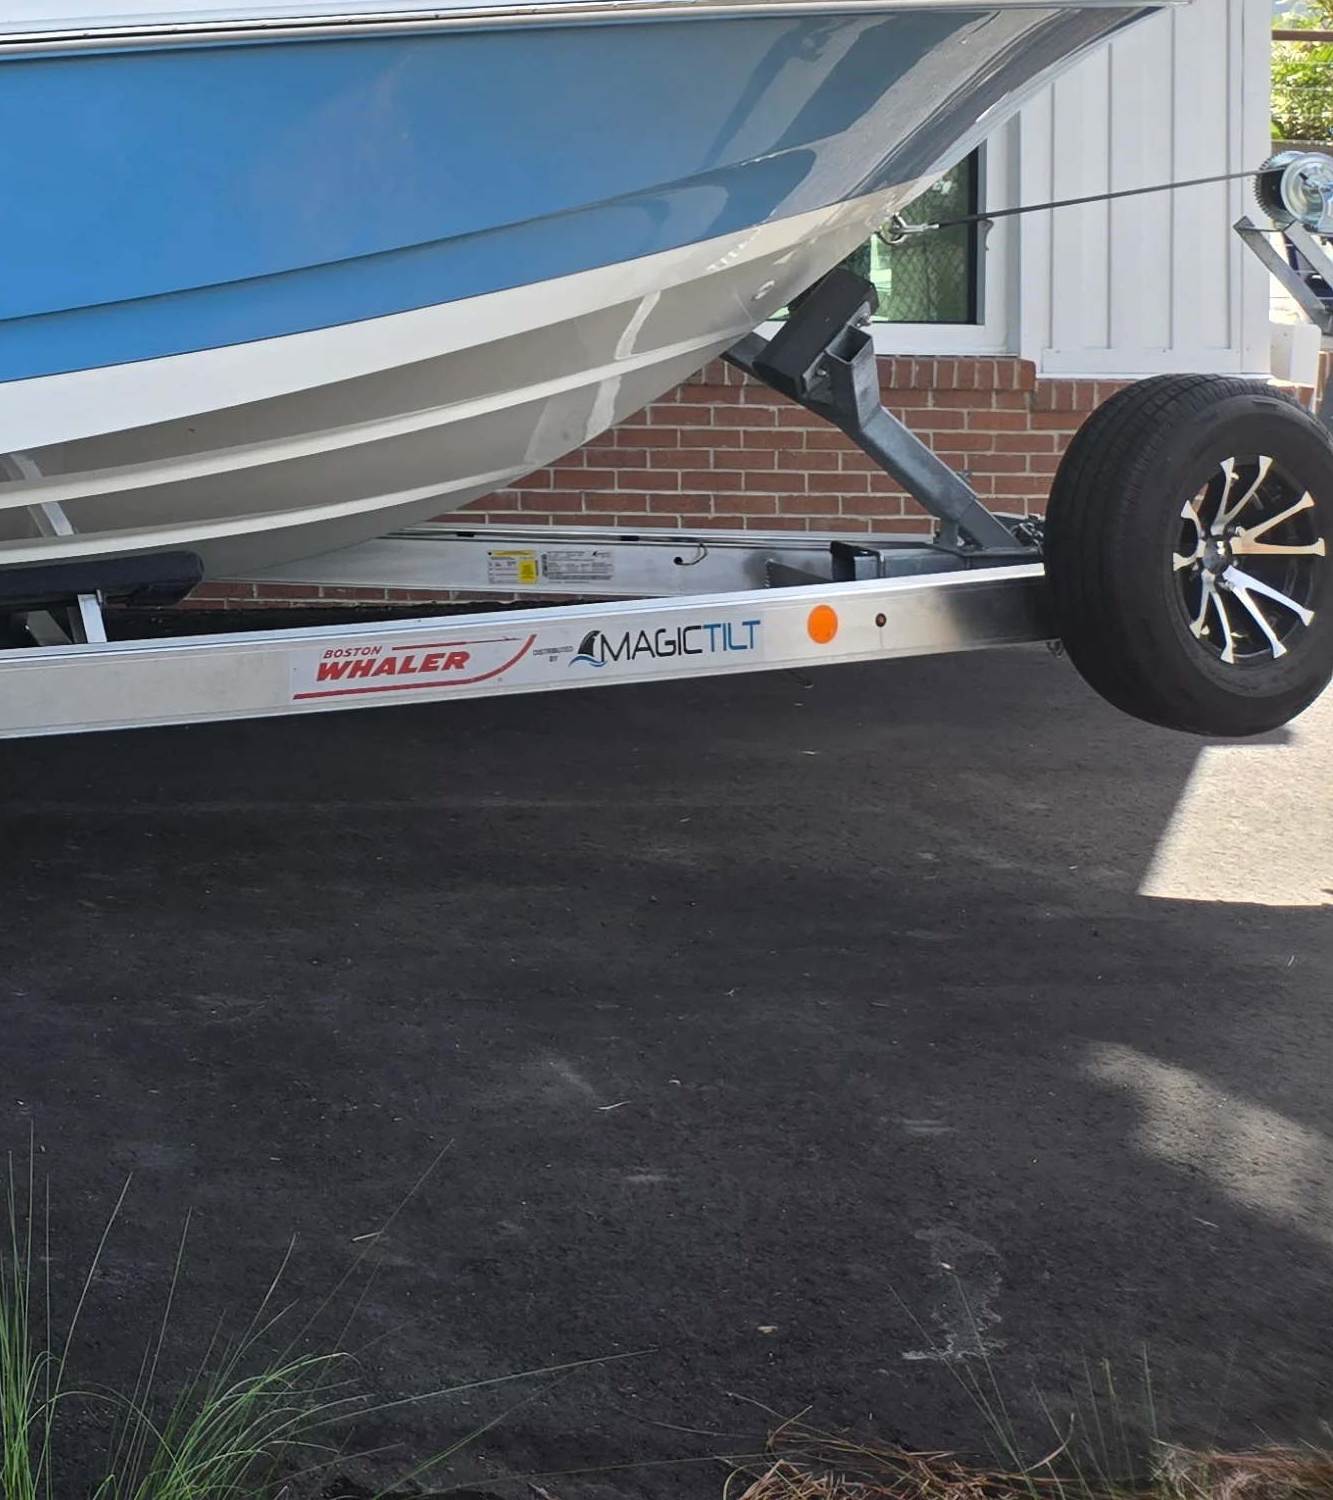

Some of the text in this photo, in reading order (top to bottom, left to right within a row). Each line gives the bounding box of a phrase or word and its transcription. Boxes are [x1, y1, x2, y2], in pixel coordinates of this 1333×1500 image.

[323, 645, 383, 659] BOSTON
[600, 620, 761, 662] MAGICTILT
[316, 651, 471, 682] WHALER
